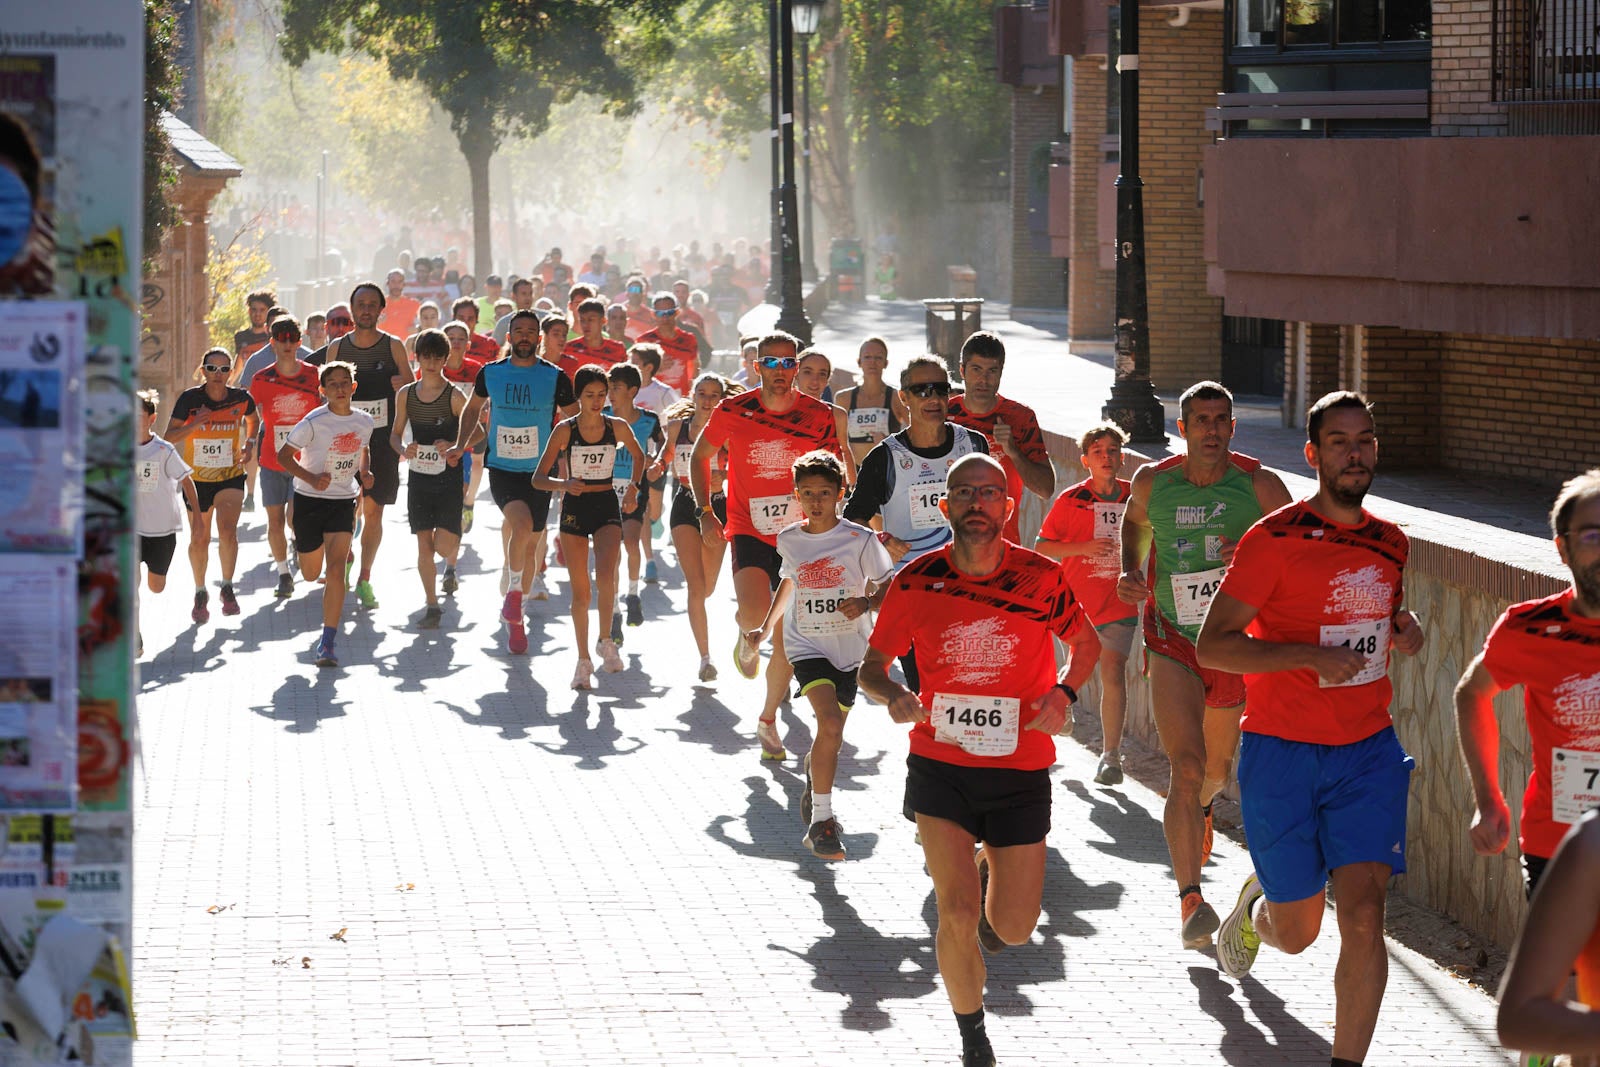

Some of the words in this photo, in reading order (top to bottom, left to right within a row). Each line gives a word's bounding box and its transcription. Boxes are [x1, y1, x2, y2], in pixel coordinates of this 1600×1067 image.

[505, 383, 532, 404] ENA
[857, 414, 877, 424] 850
[502, 434, 530, 445] 1343
[202, 445, 222, 455] 561
[750, 449, 795, 459] carrera
[418, 451, 438, 461] 240
[582, 453, 605, 464] 797
[335, 459, 354, 470] 306
[762, 503, 789, 517] 127
[1175, 506, 1207, 524] ATARFE
[798, 567, 840, 581] carrera
[1333, 586, 1392, 601] carrera
[943, 637, 1012, 653] carrera
[945, 706, 1003, 727] 1466
[964, 729, 985, 737] DANIEL
